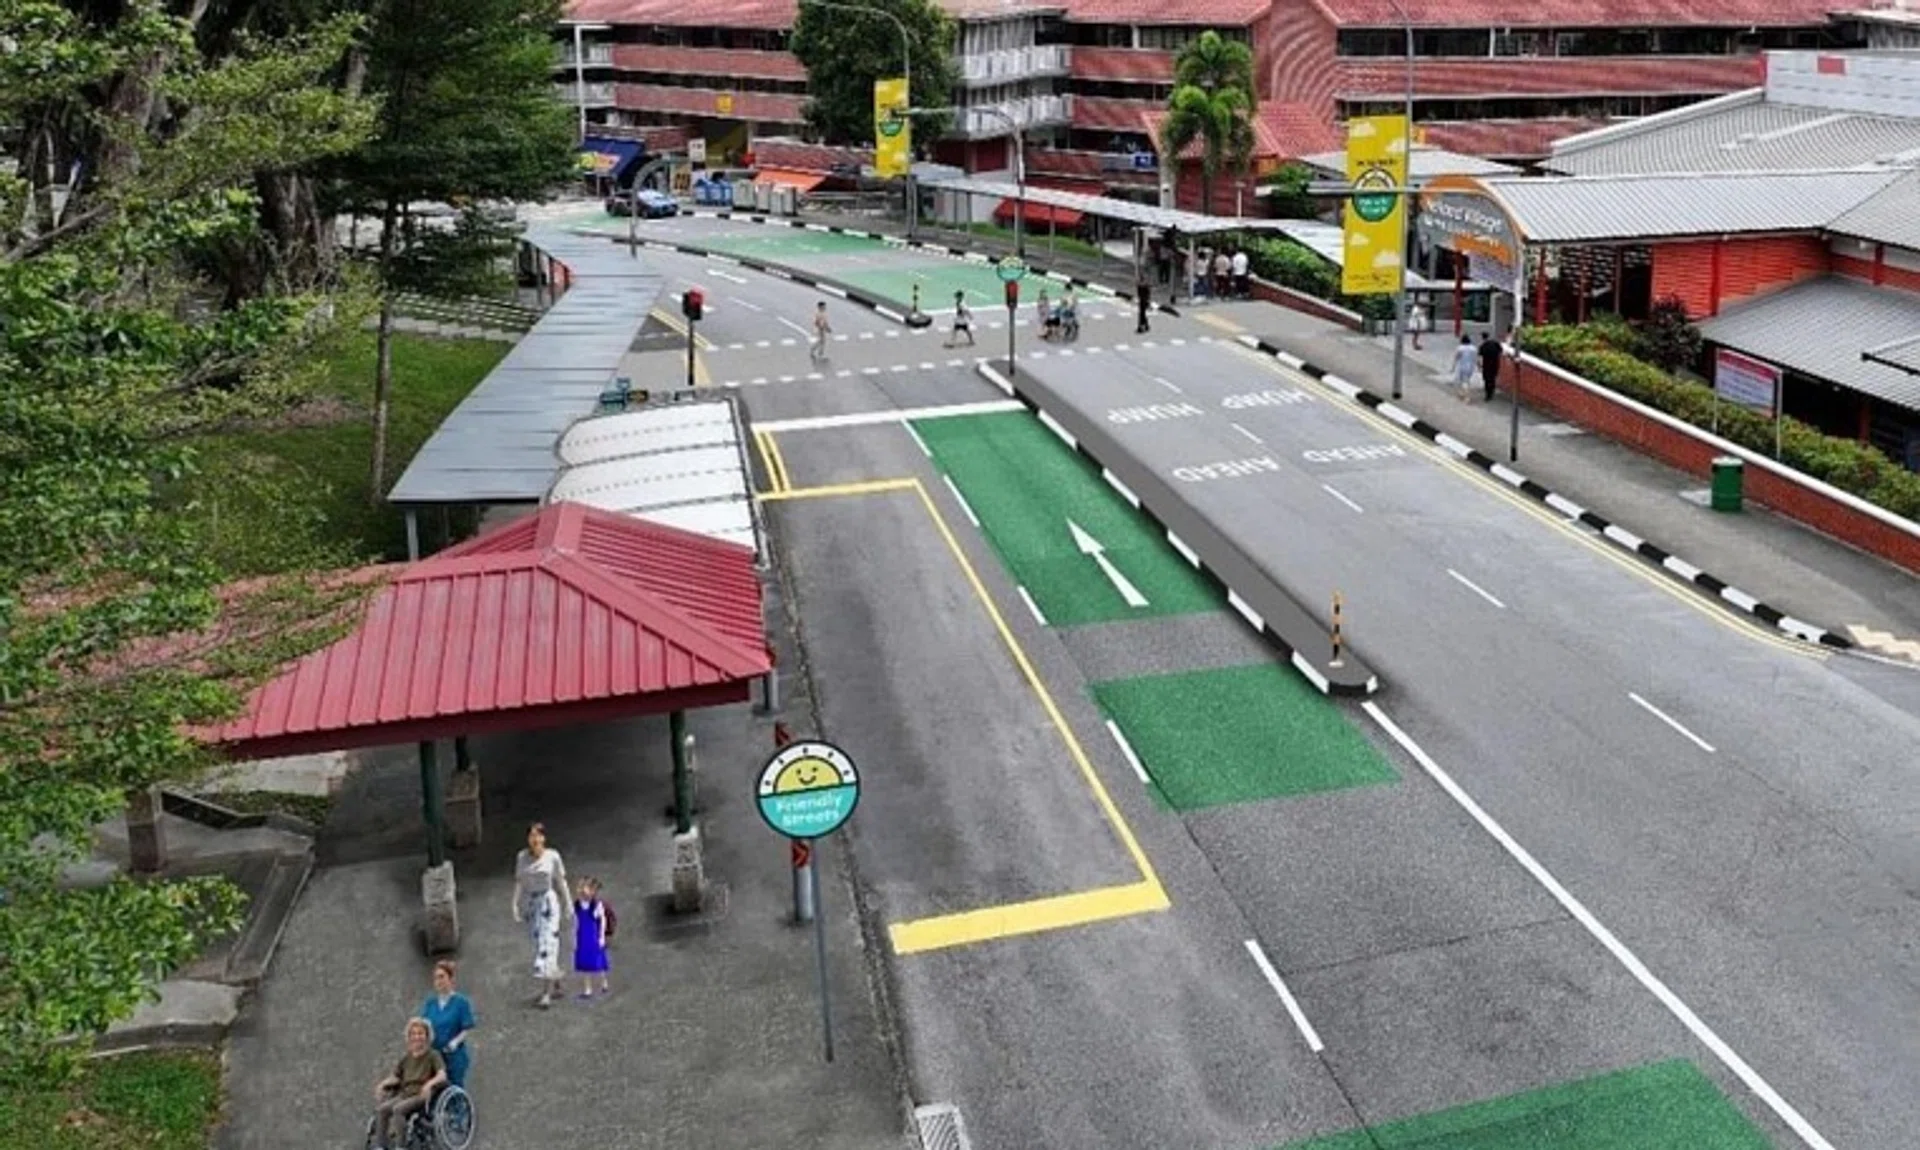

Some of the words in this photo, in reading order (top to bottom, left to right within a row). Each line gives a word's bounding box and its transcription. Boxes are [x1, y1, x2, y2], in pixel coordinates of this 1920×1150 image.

[1222, 388, 1316, 409] HUMP
[1107, 402, 1204, 424] HUMP
[1302, 444, 1407, 463] AHEAD
[1172, 457, 1280, 481] AHEAD
[776, 791, 844, 813] Friendly
